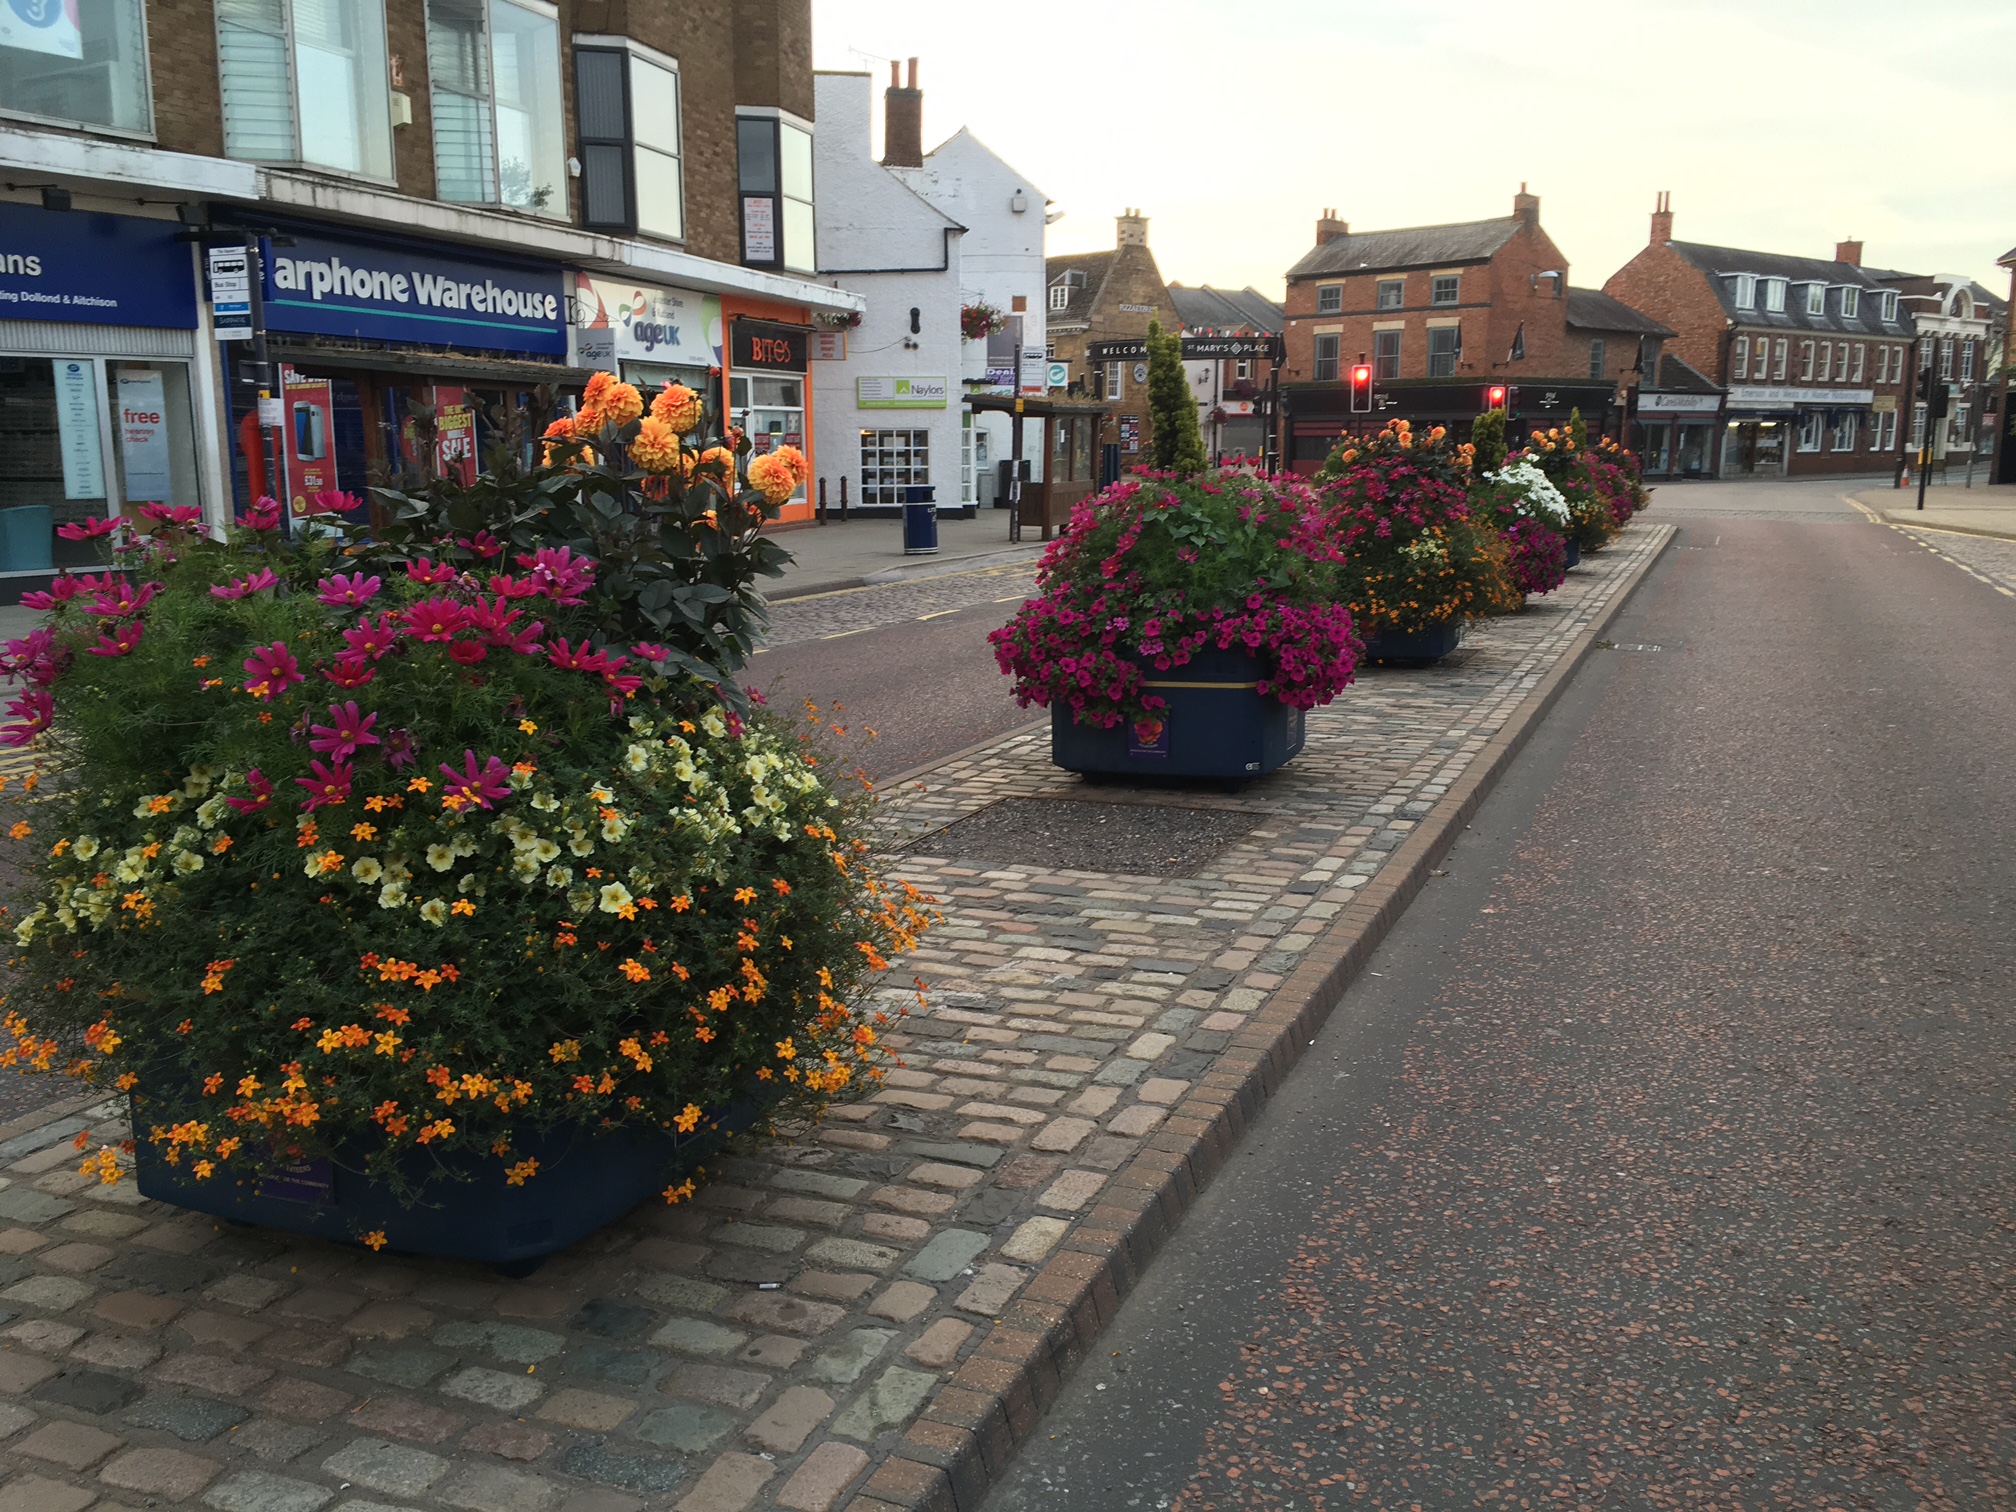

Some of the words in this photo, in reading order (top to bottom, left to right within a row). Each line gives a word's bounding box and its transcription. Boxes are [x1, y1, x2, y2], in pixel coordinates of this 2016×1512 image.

[274, 257, 409, 302] arphone
[411, 271, 558, 321] Warehouse
[20, 291, 61, 304] Dollond
[62, 295, 71, 304] &
[72, 295, 118, 307] Aitchison
[1196, 344, 1229, 352] MARY'S
[1243, 344, 1270, 352] PLACE
[911, 384, 945, 397] Naylors
[123, 408, 160, 424] free
[438, 413, 472, 431] BIGGEST
[441, 437, 472, 462] SALE
